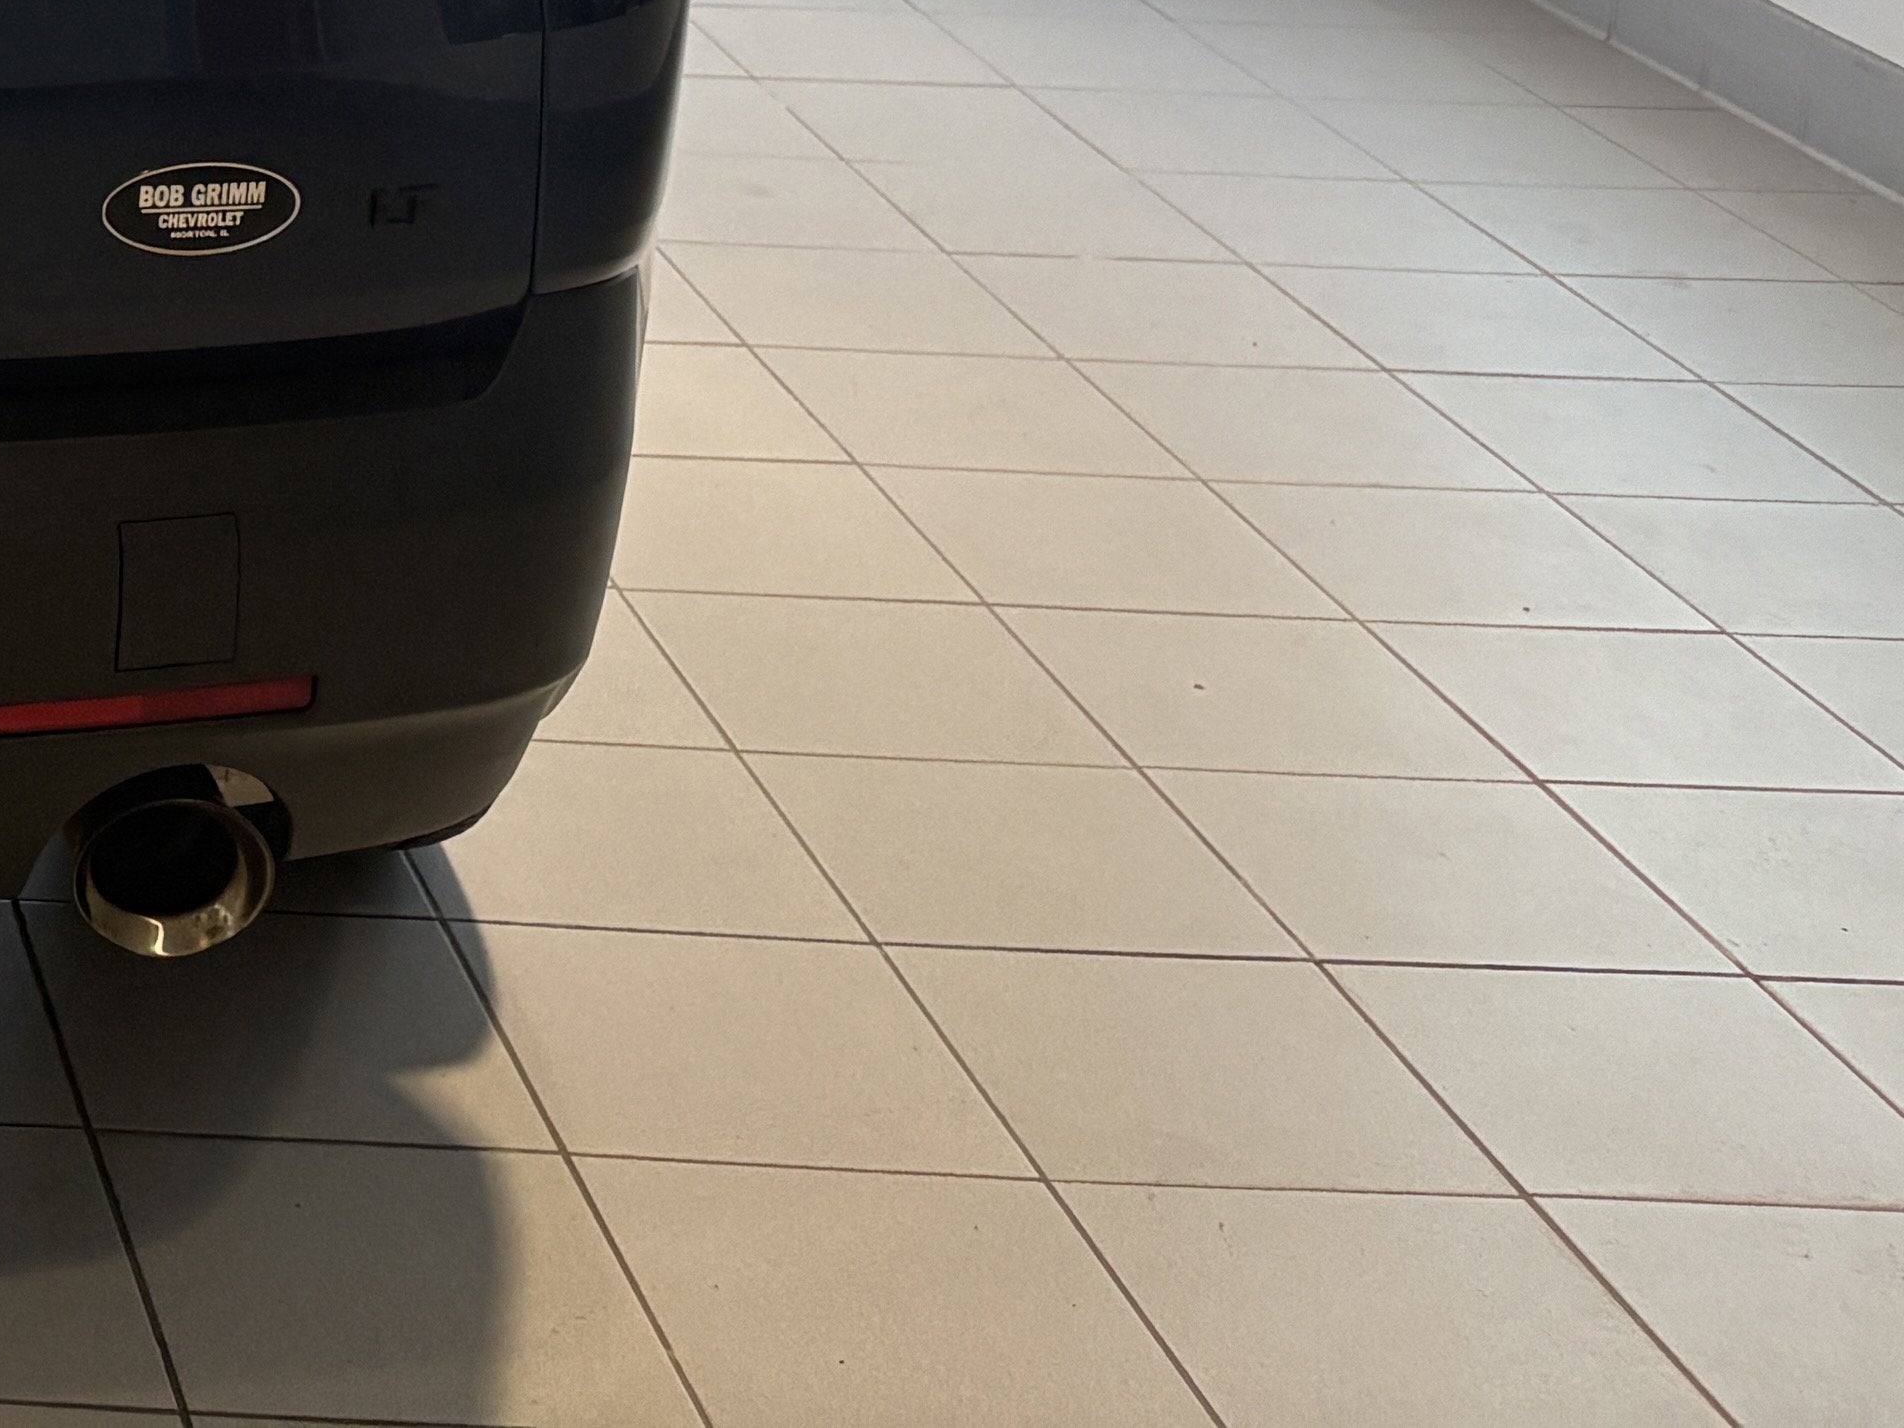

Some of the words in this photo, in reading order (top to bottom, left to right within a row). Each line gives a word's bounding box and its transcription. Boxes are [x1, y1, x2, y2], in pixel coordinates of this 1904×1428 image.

[138, 184, 186, 208] BOB
[190, 180, 268, 206] GRIMM
[158, 211, 245, 229] CHEVROLET
